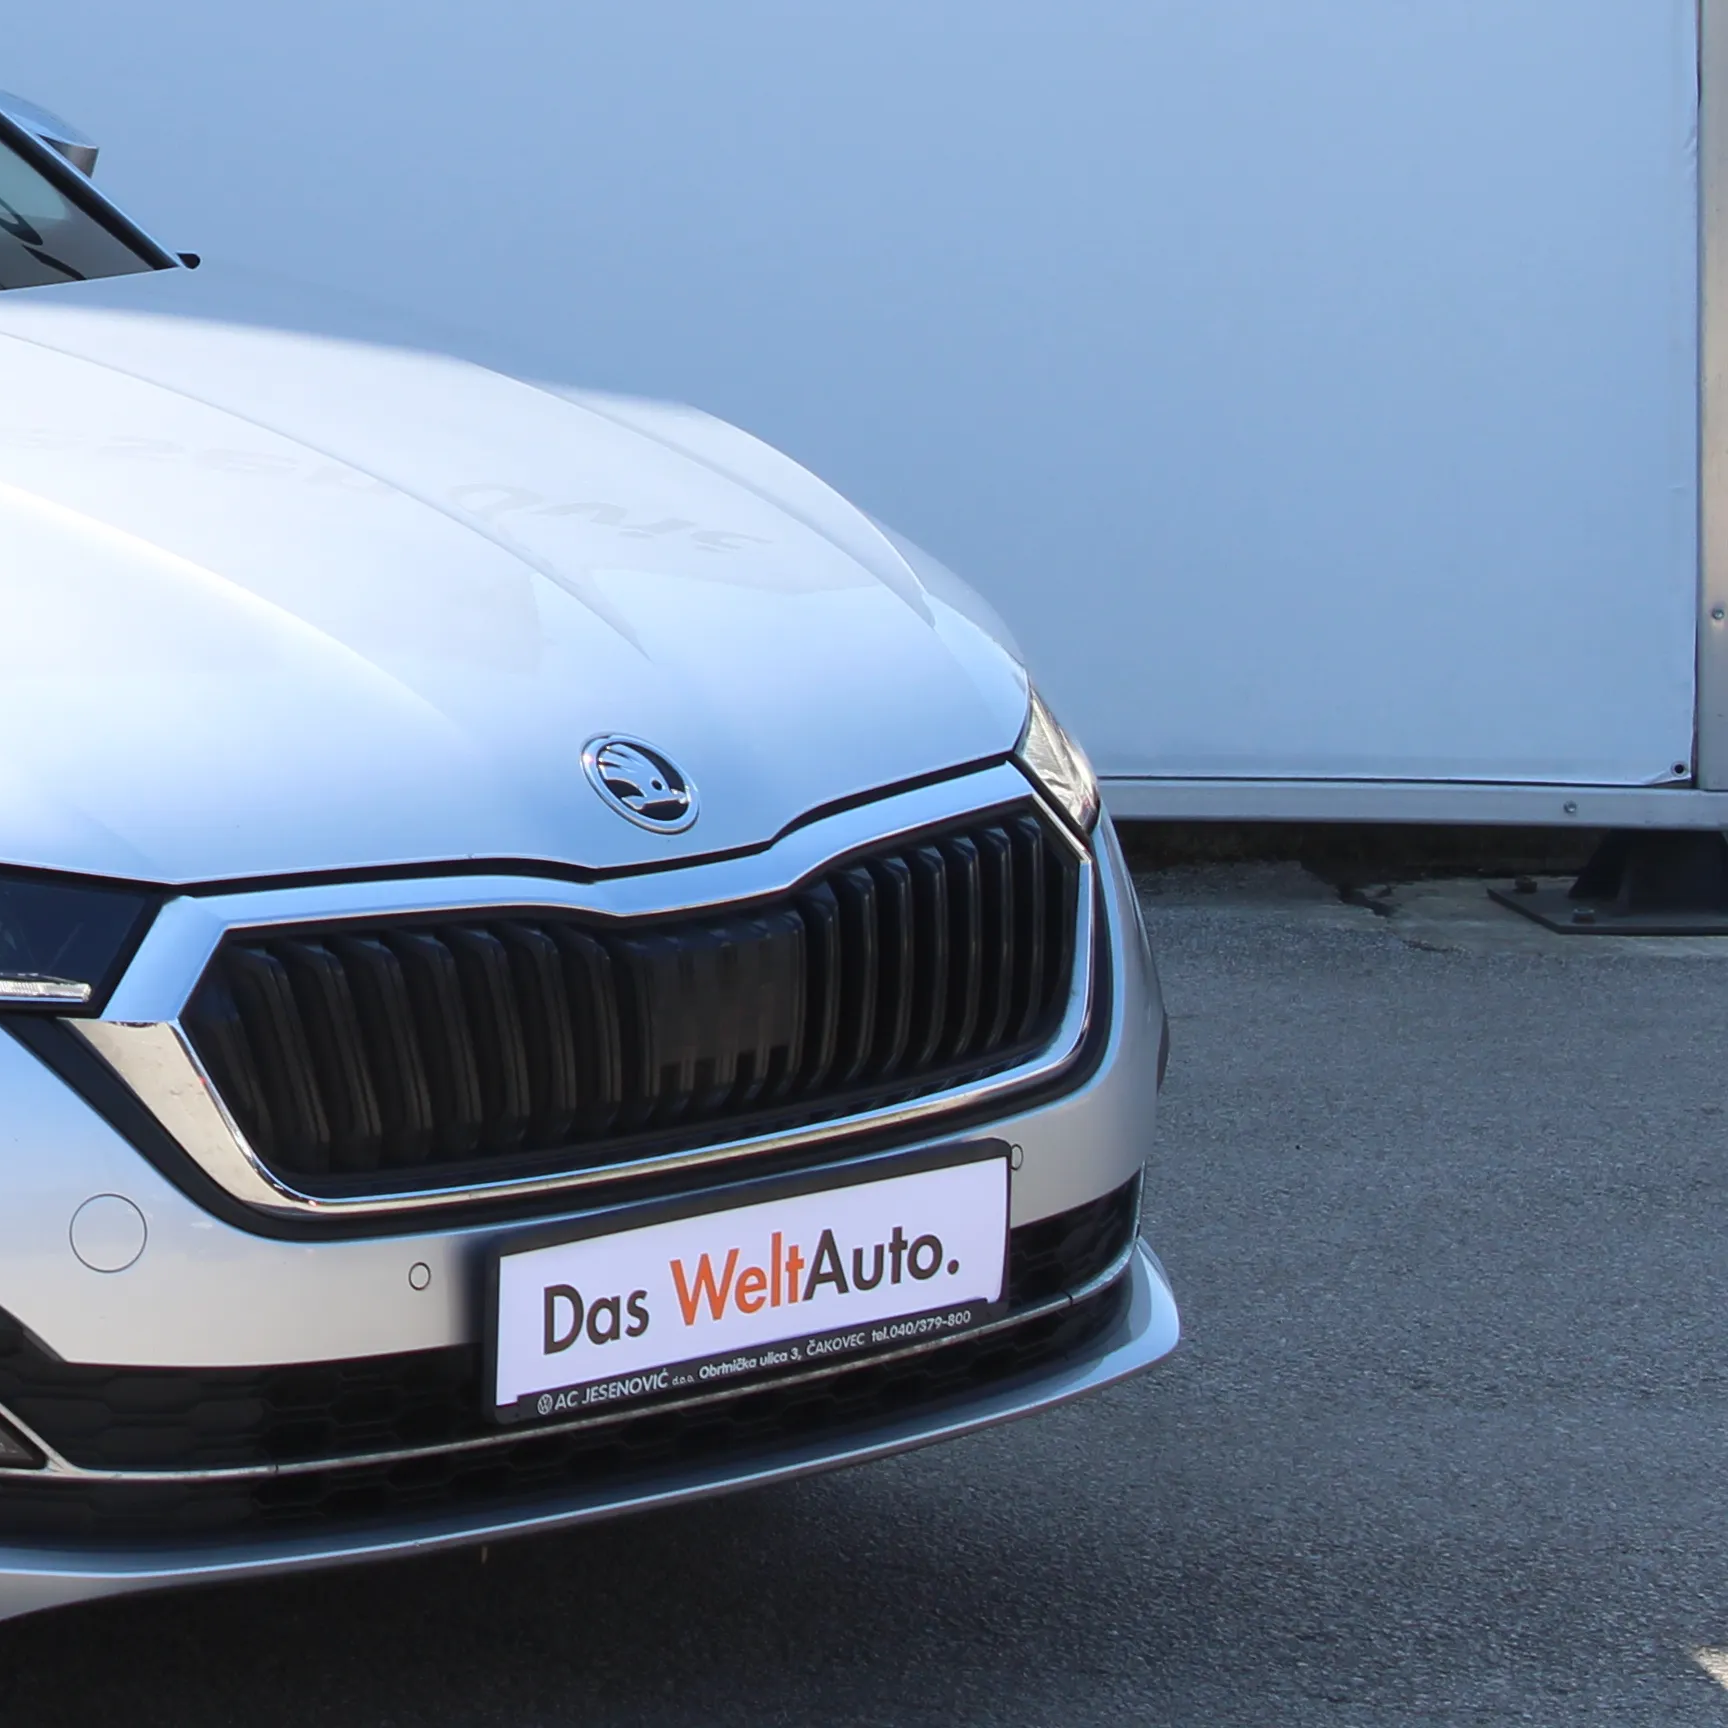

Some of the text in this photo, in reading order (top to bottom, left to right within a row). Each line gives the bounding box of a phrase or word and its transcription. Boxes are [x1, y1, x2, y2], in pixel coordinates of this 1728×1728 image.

[543, 1226, 960, 1355] Das WeltAuto.
[554, 1390, 579, 1411] AC
[581, 1368, 670, 1404] JESENOVIĆ
[699, 1356, 757, 1379] Obrtnička
[759, 1350, 788, 1367] ulica
[806, 1332, 866, 1356] ČAKOVEC
